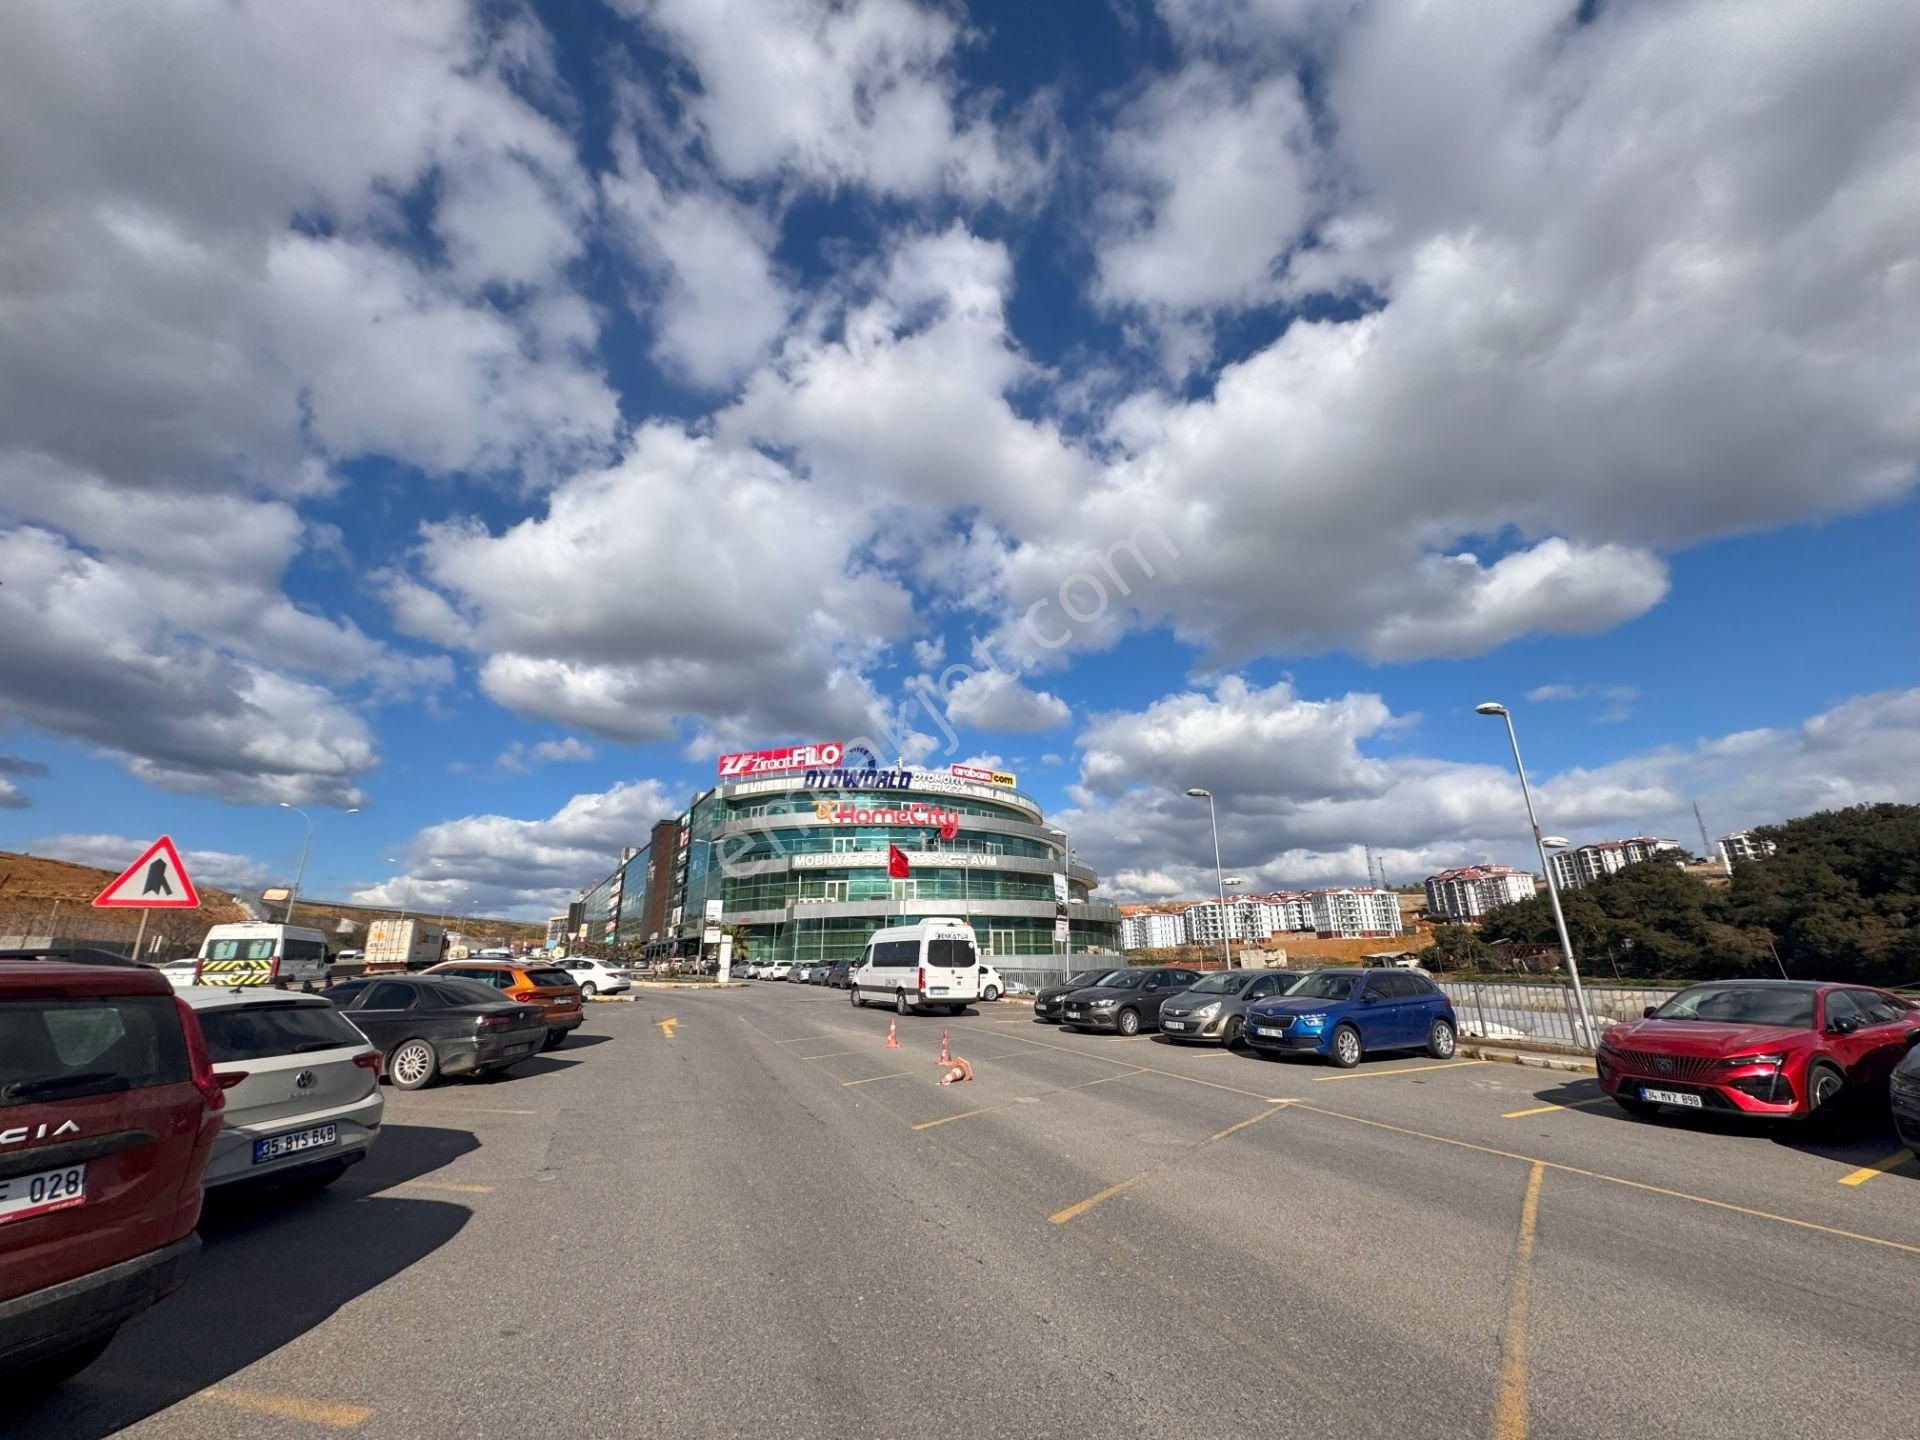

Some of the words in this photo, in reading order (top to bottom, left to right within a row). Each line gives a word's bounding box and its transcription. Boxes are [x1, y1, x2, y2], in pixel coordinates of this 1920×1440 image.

[804, 769, 911, 789] OTOWORLD
[835, 802, 958, 839] HomeCity
[871, 851, 969, 866] DERASYON
[971, 855, 997, 867] AVM
[1648, 1090, 1657, 1100] 34
[0, 1119, 80, 1145] CIA
[262, 1137, 279, 1156] 35
[285, 1132, 309, 1151] BYS
[312, 1126, 334, 1144] 648
[30, 1169, 80, 1203] 028
